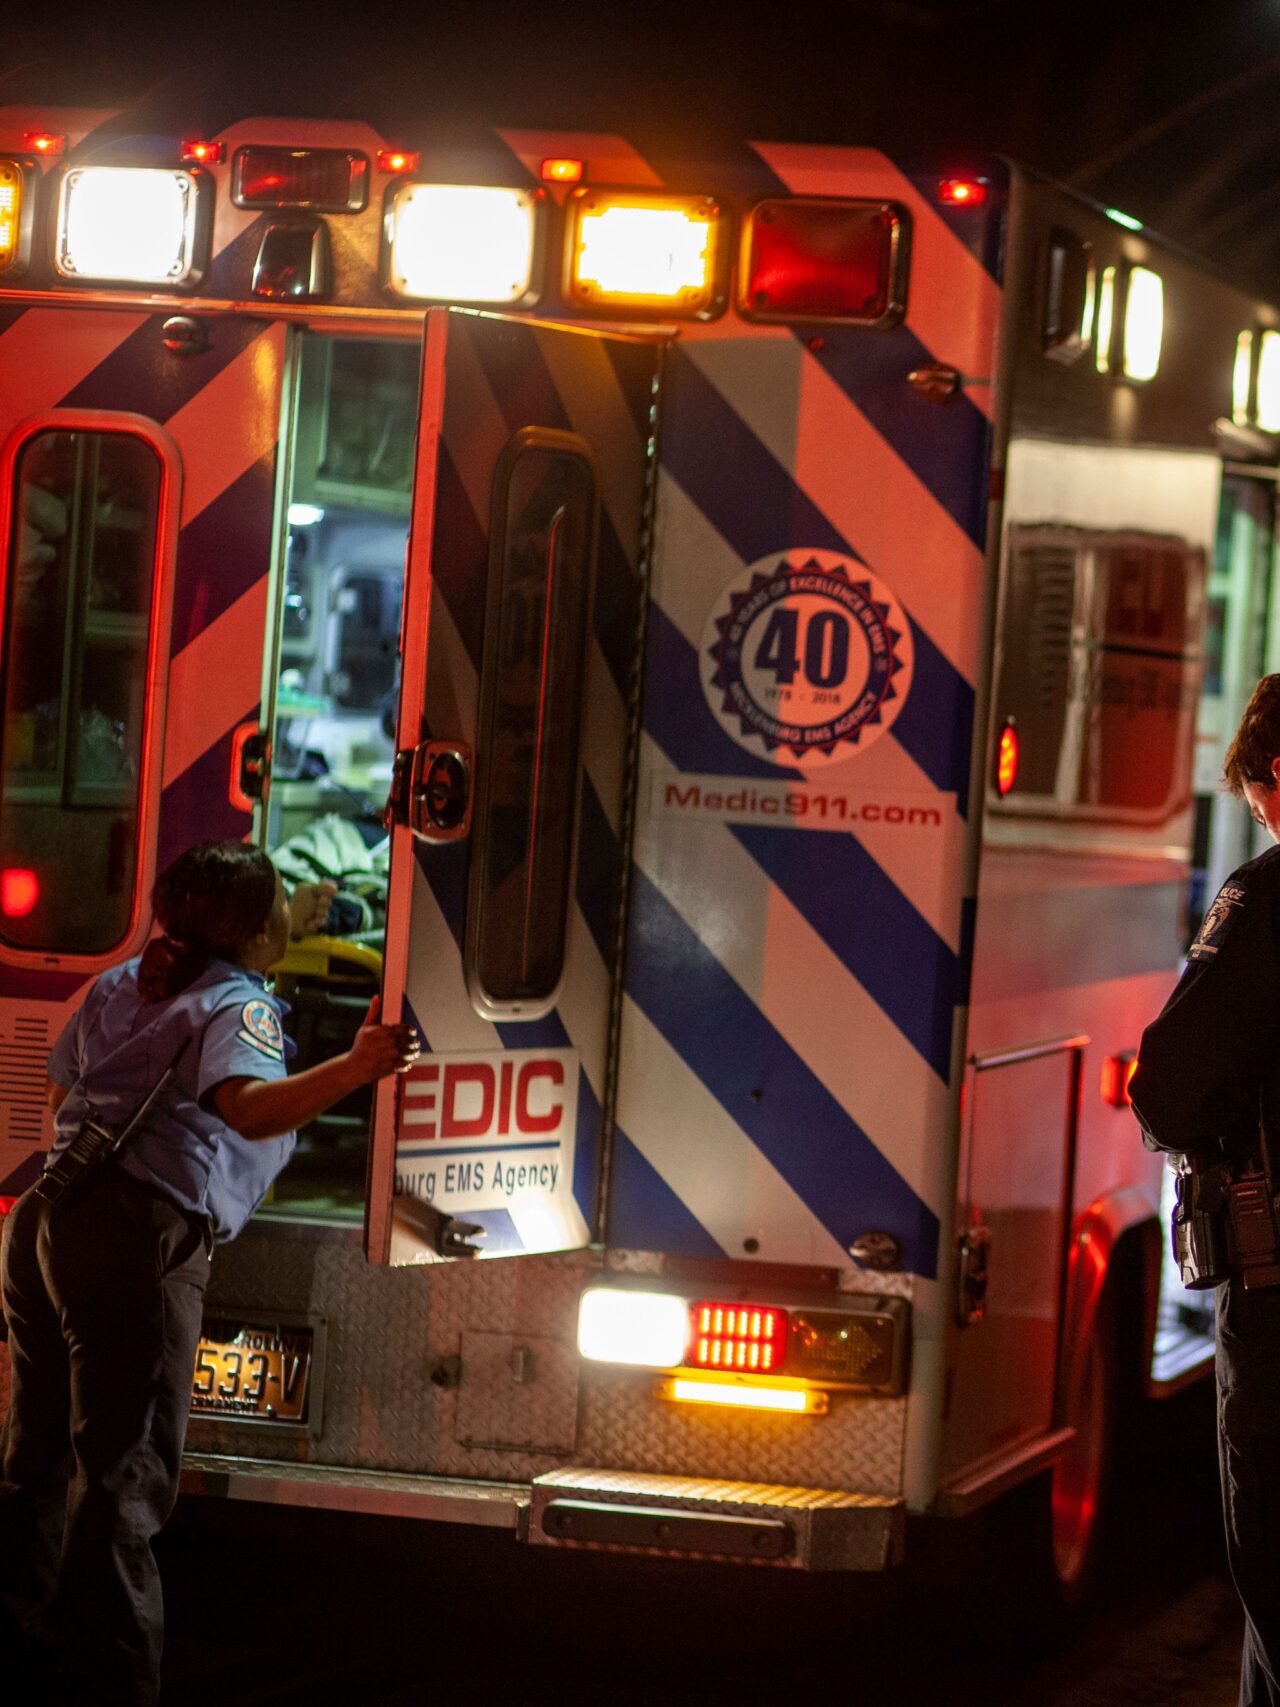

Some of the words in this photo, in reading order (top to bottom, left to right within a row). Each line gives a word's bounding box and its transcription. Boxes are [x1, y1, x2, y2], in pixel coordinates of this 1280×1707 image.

[789, 576, 865, 612] EXCELLENCE
[860, 605, 875, 625] IN
[754, 609, 850, 689] 40
[803, 725, 833, 744] EMS
[664, 783, 942, 827] Medic911.com
[397, 1059, 565, 1140] EDIC
[444, 1161, 485, 1194] EMS
[492, 1160, 560, 1197] Agency
